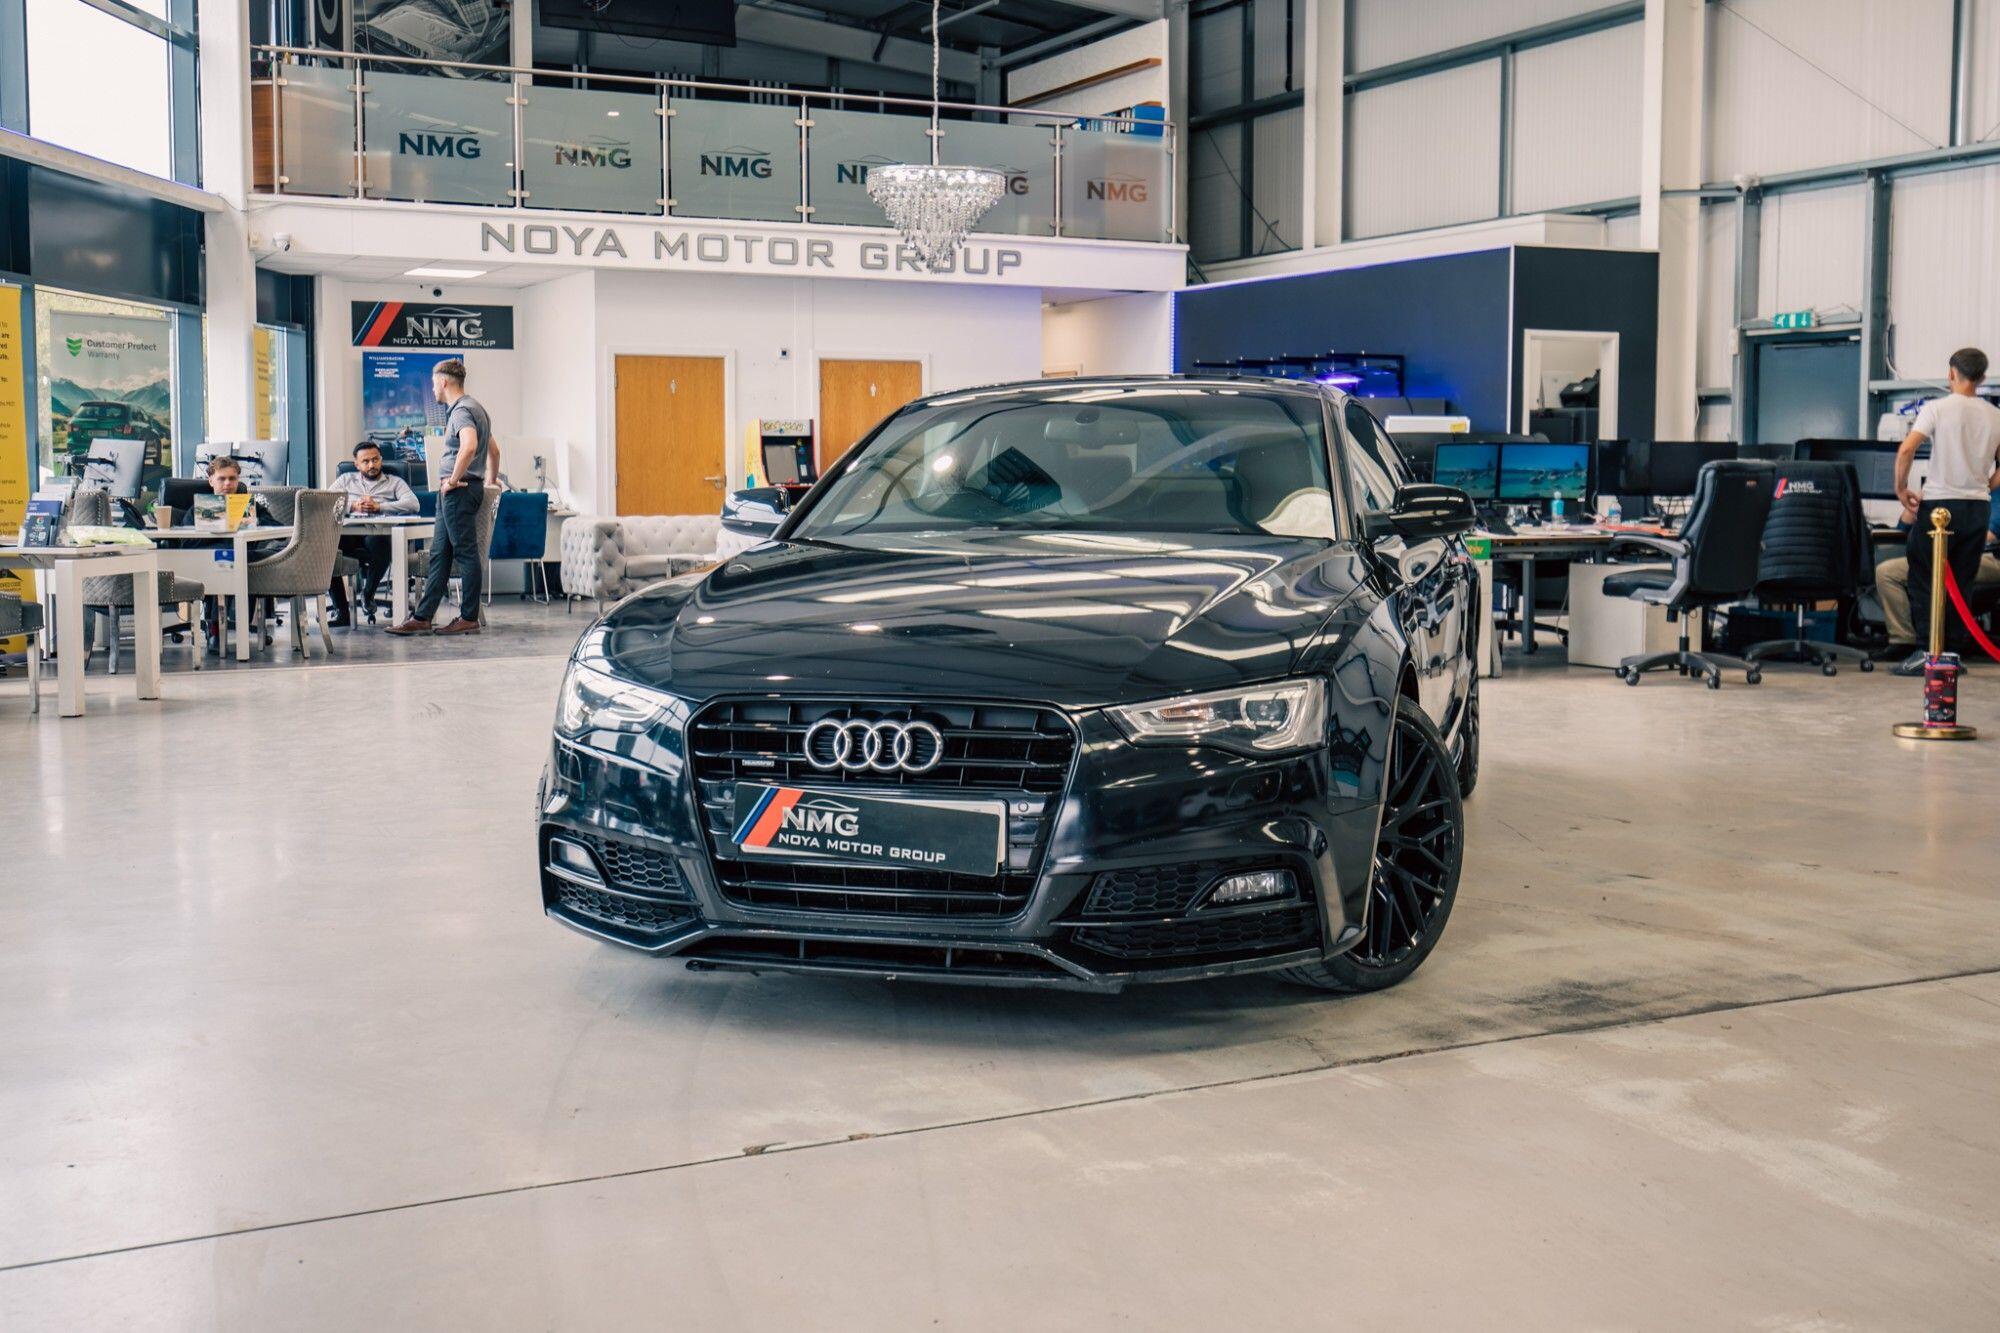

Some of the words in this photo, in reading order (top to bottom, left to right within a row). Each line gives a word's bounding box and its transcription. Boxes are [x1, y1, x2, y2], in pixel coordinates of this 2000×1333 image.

[399, 132, 481, 160] NMG
[555, 144, 632, 170] NMG
[700, 154, 772, 180] NMG
[1087, 180, 1148, 204] NMG
[481, 222, 628, 259] NOYA
[654, 230, 835, 269] MOTOR
[860, 242, 1022, 277] GROUP
[405, 316, 484, 340] NMG
[86, 339, 125, 350] Customer
[127, 341, 157, 352] Protect
[87, 350, 120, 360] Warranty
[392, 336, 420, 346] NOYA
[423, 338, 459, 347] MOTOR
[461, 339, 497, 348] GROUP
[780, 805, 859, 838] NMG
[778, 833, 821, 849] NOYA
[826, 839, 883, 856] MOTOR
[889, 846, 947, 864] GROUP
